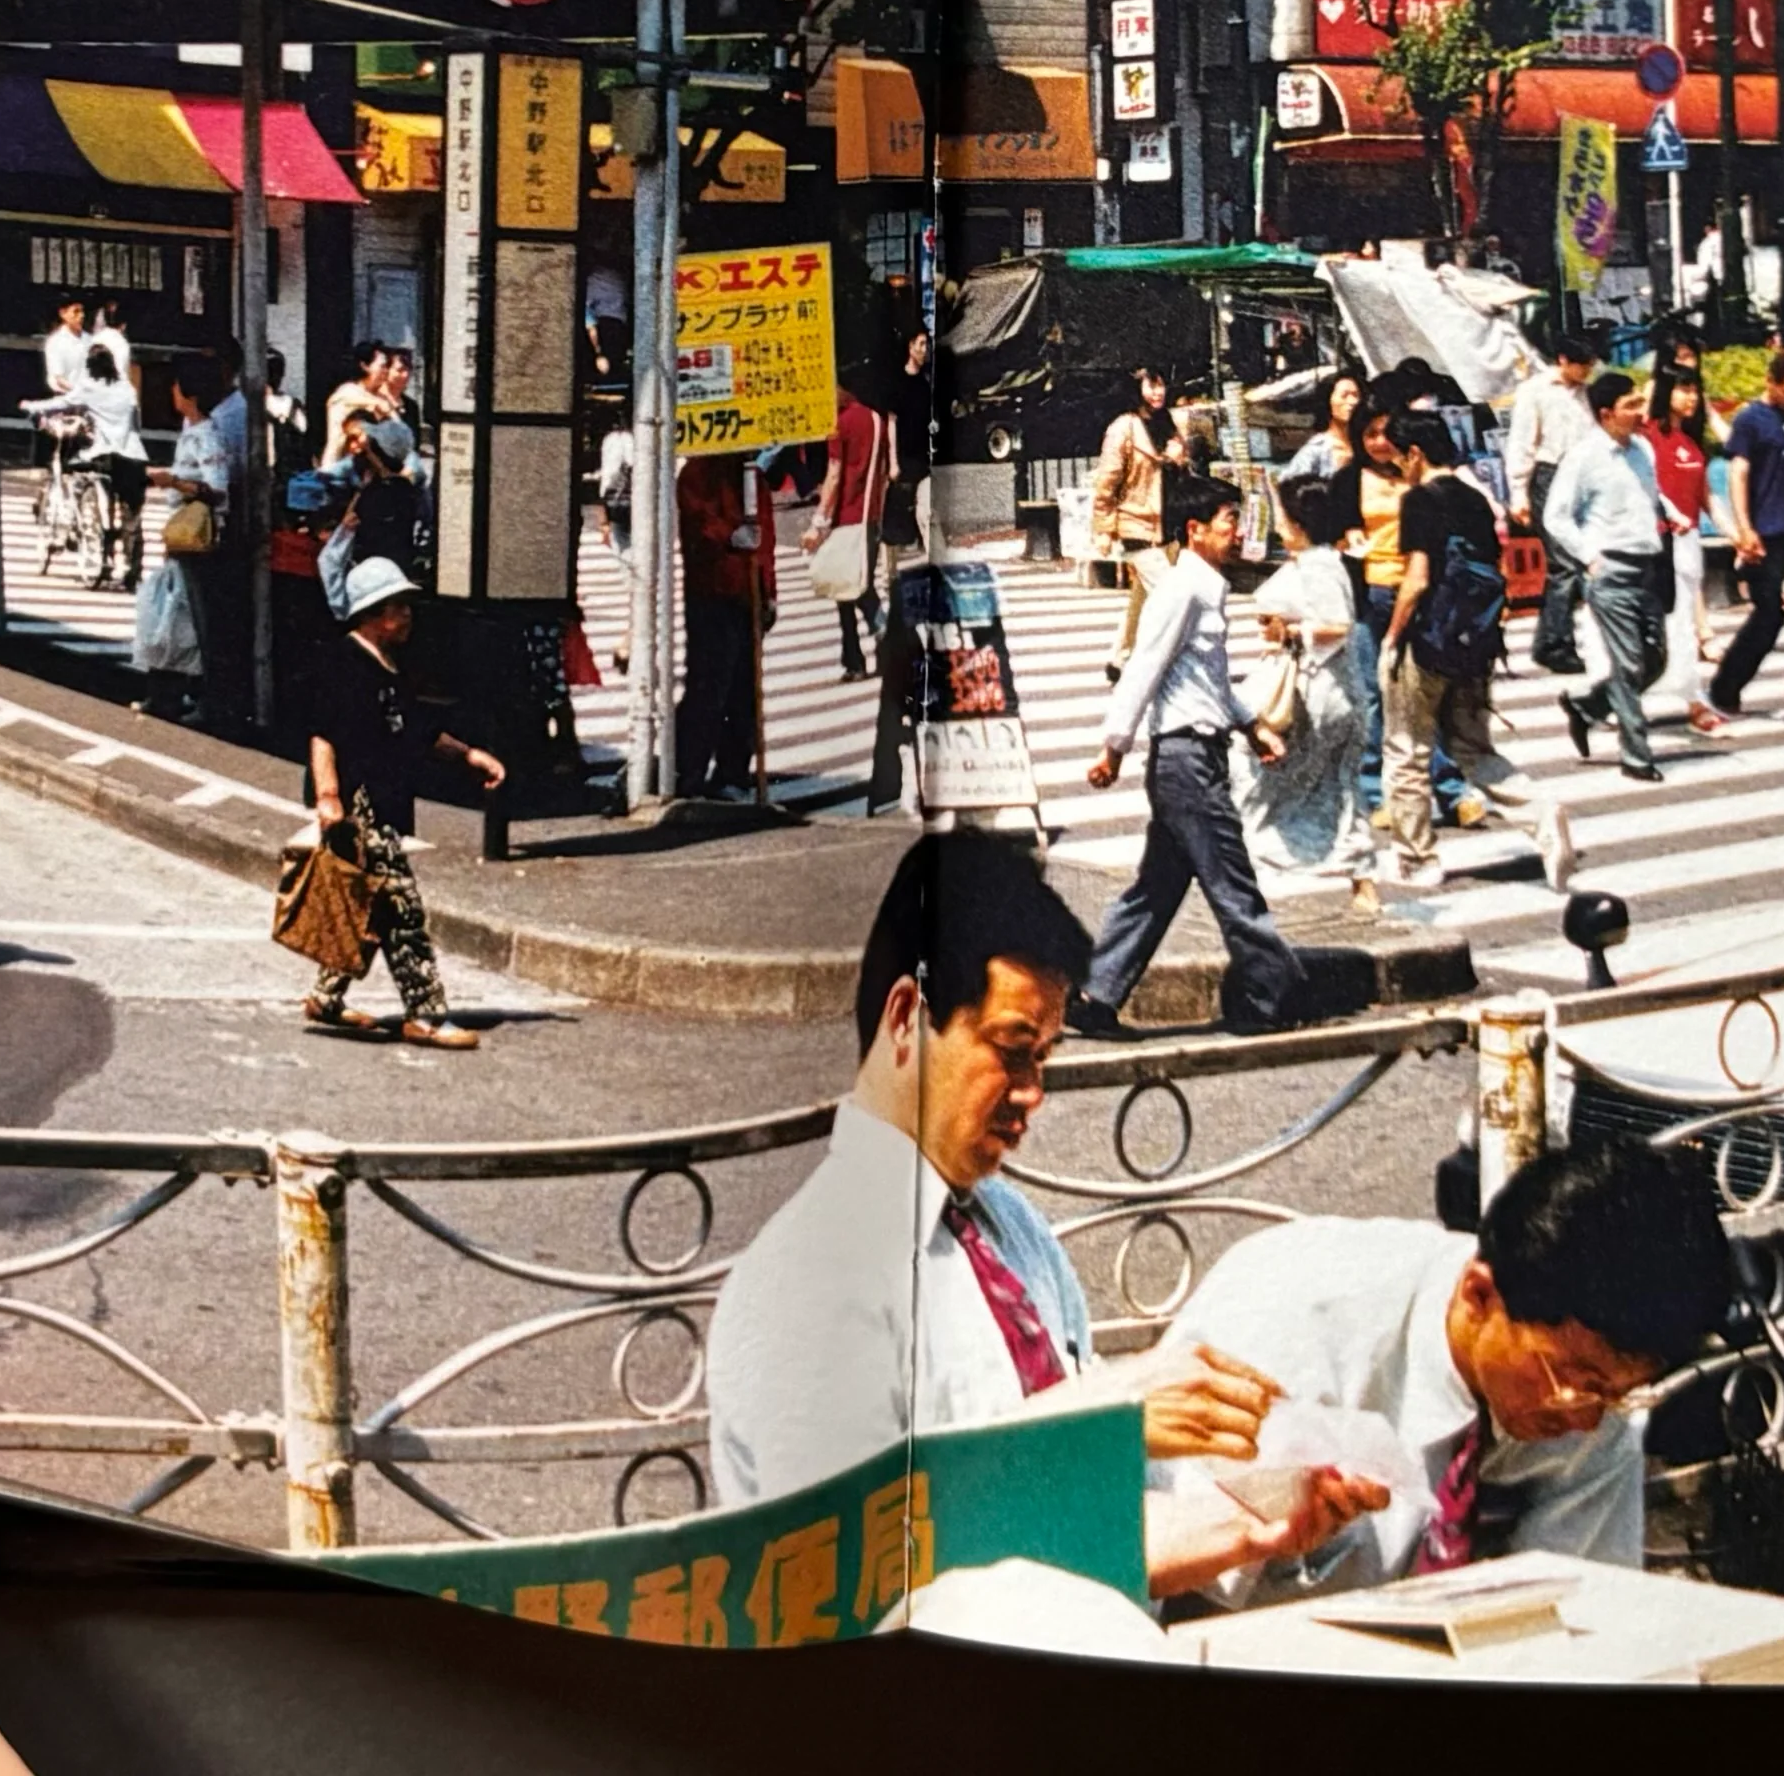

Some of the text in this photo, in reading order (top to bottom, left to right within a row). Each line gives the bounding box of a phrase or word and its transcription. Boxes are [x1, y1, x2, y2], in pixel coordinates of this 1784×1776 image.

[719, 252, 823, 293] エステ
[441, 1471, 934, 1649] 野郵便局
